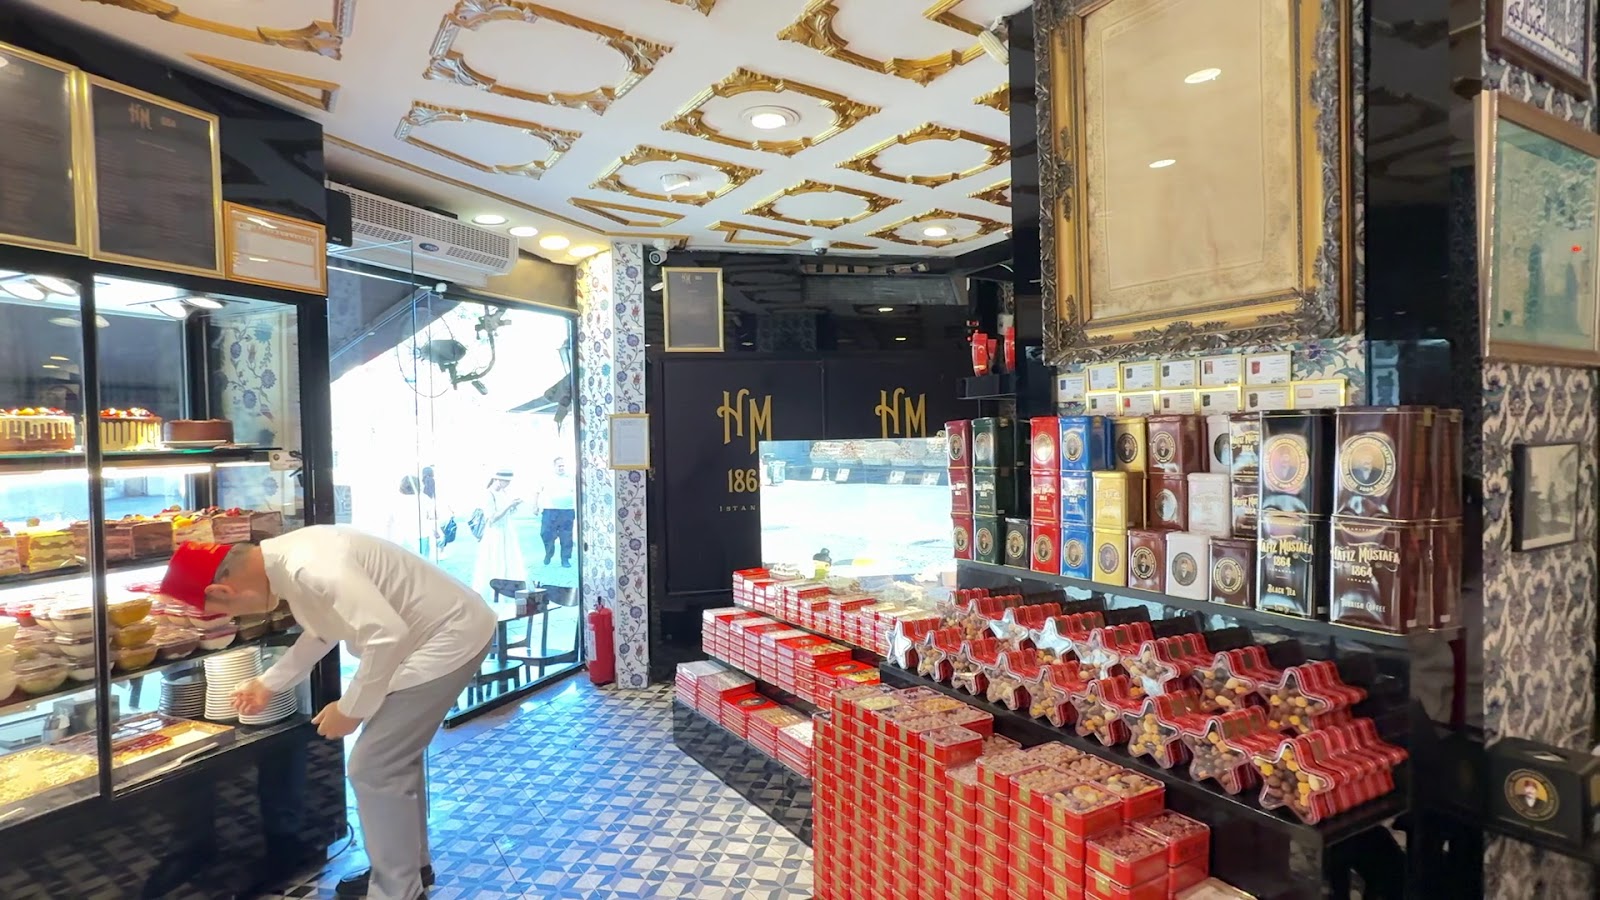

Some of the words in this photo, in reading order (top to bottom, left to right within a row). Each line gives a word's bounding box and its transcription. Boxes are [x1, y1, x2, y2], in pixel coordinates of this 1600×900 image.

[716, 388, 772, 455] HM
[875, 387, 926, 438] HM
[727, 468, 759, 493] 186
[1279, 539, 1314, 556] MUSTAFA
[1358, 545, 1400, 567] MUSTAFA
[1273, 555, 1291, 568] 1864
[1351, 565, 1373, 578] 1864
